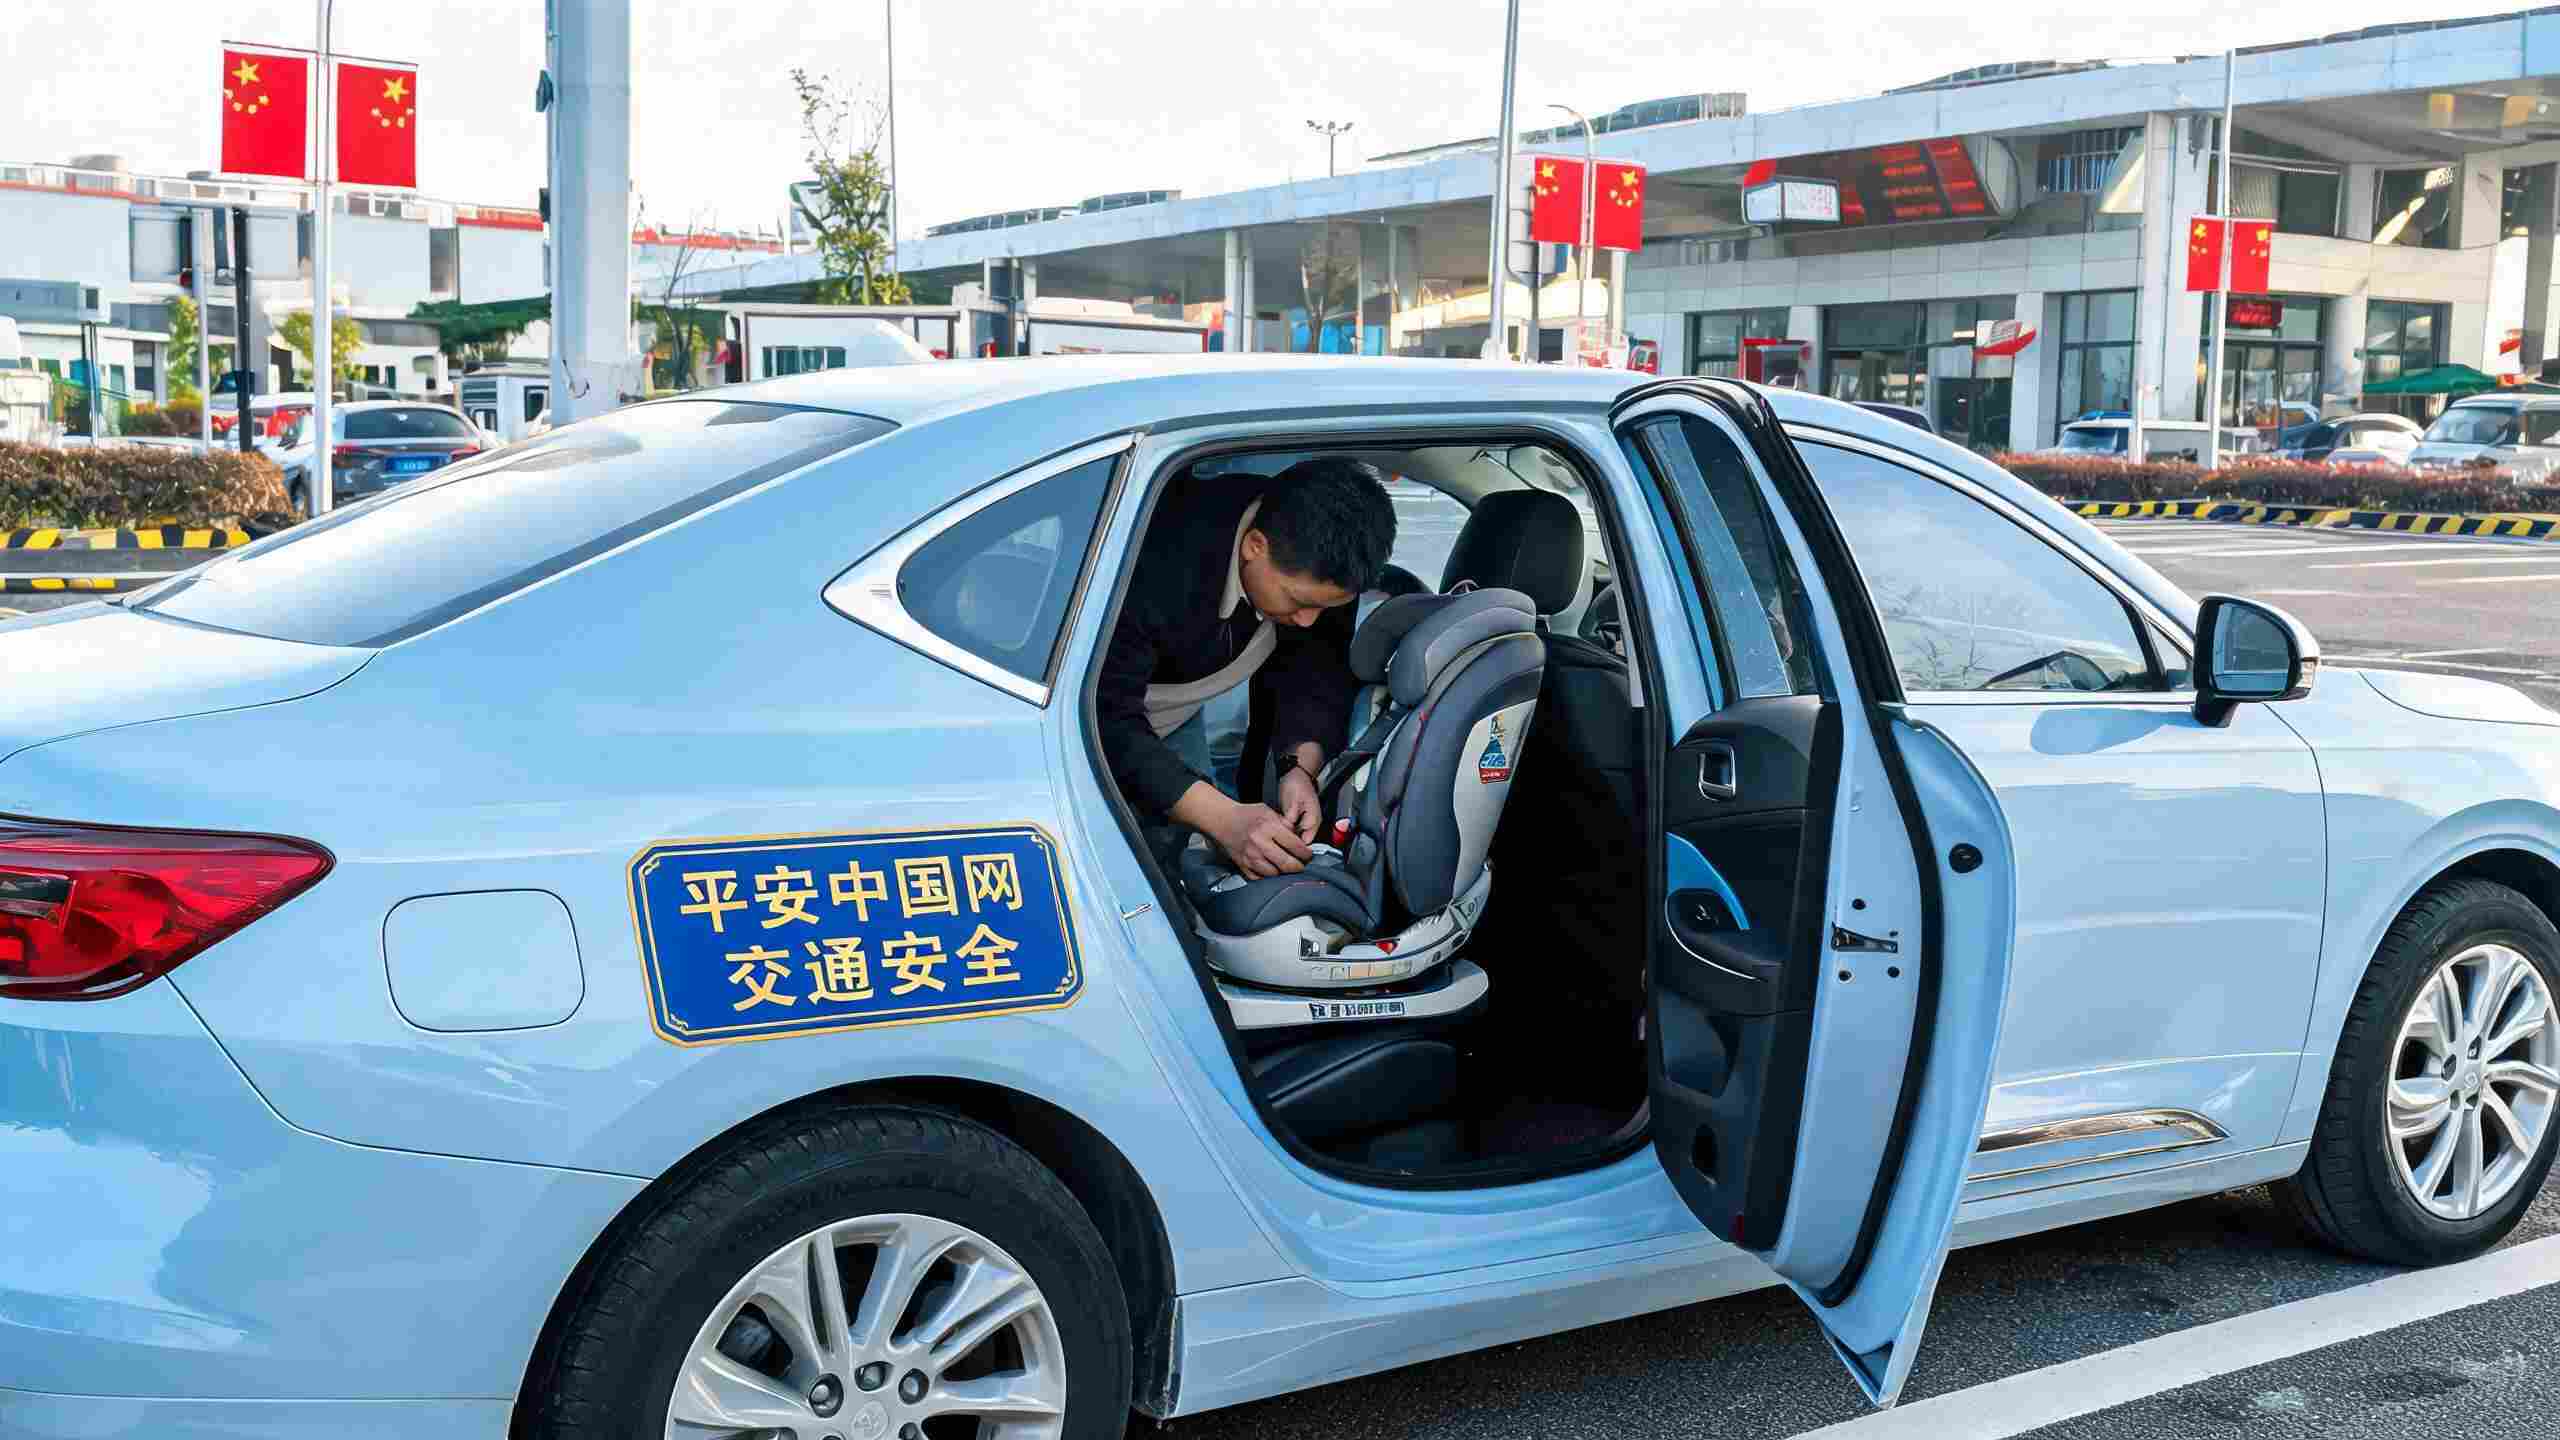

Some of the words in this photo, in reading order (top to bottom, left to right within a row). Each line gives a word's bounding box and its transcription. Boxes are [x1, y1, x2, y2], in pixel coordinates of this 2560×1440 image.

[680, 853, 1023, 933] 平安中国网
[725, 923, 1022, 1012] 交通安全
